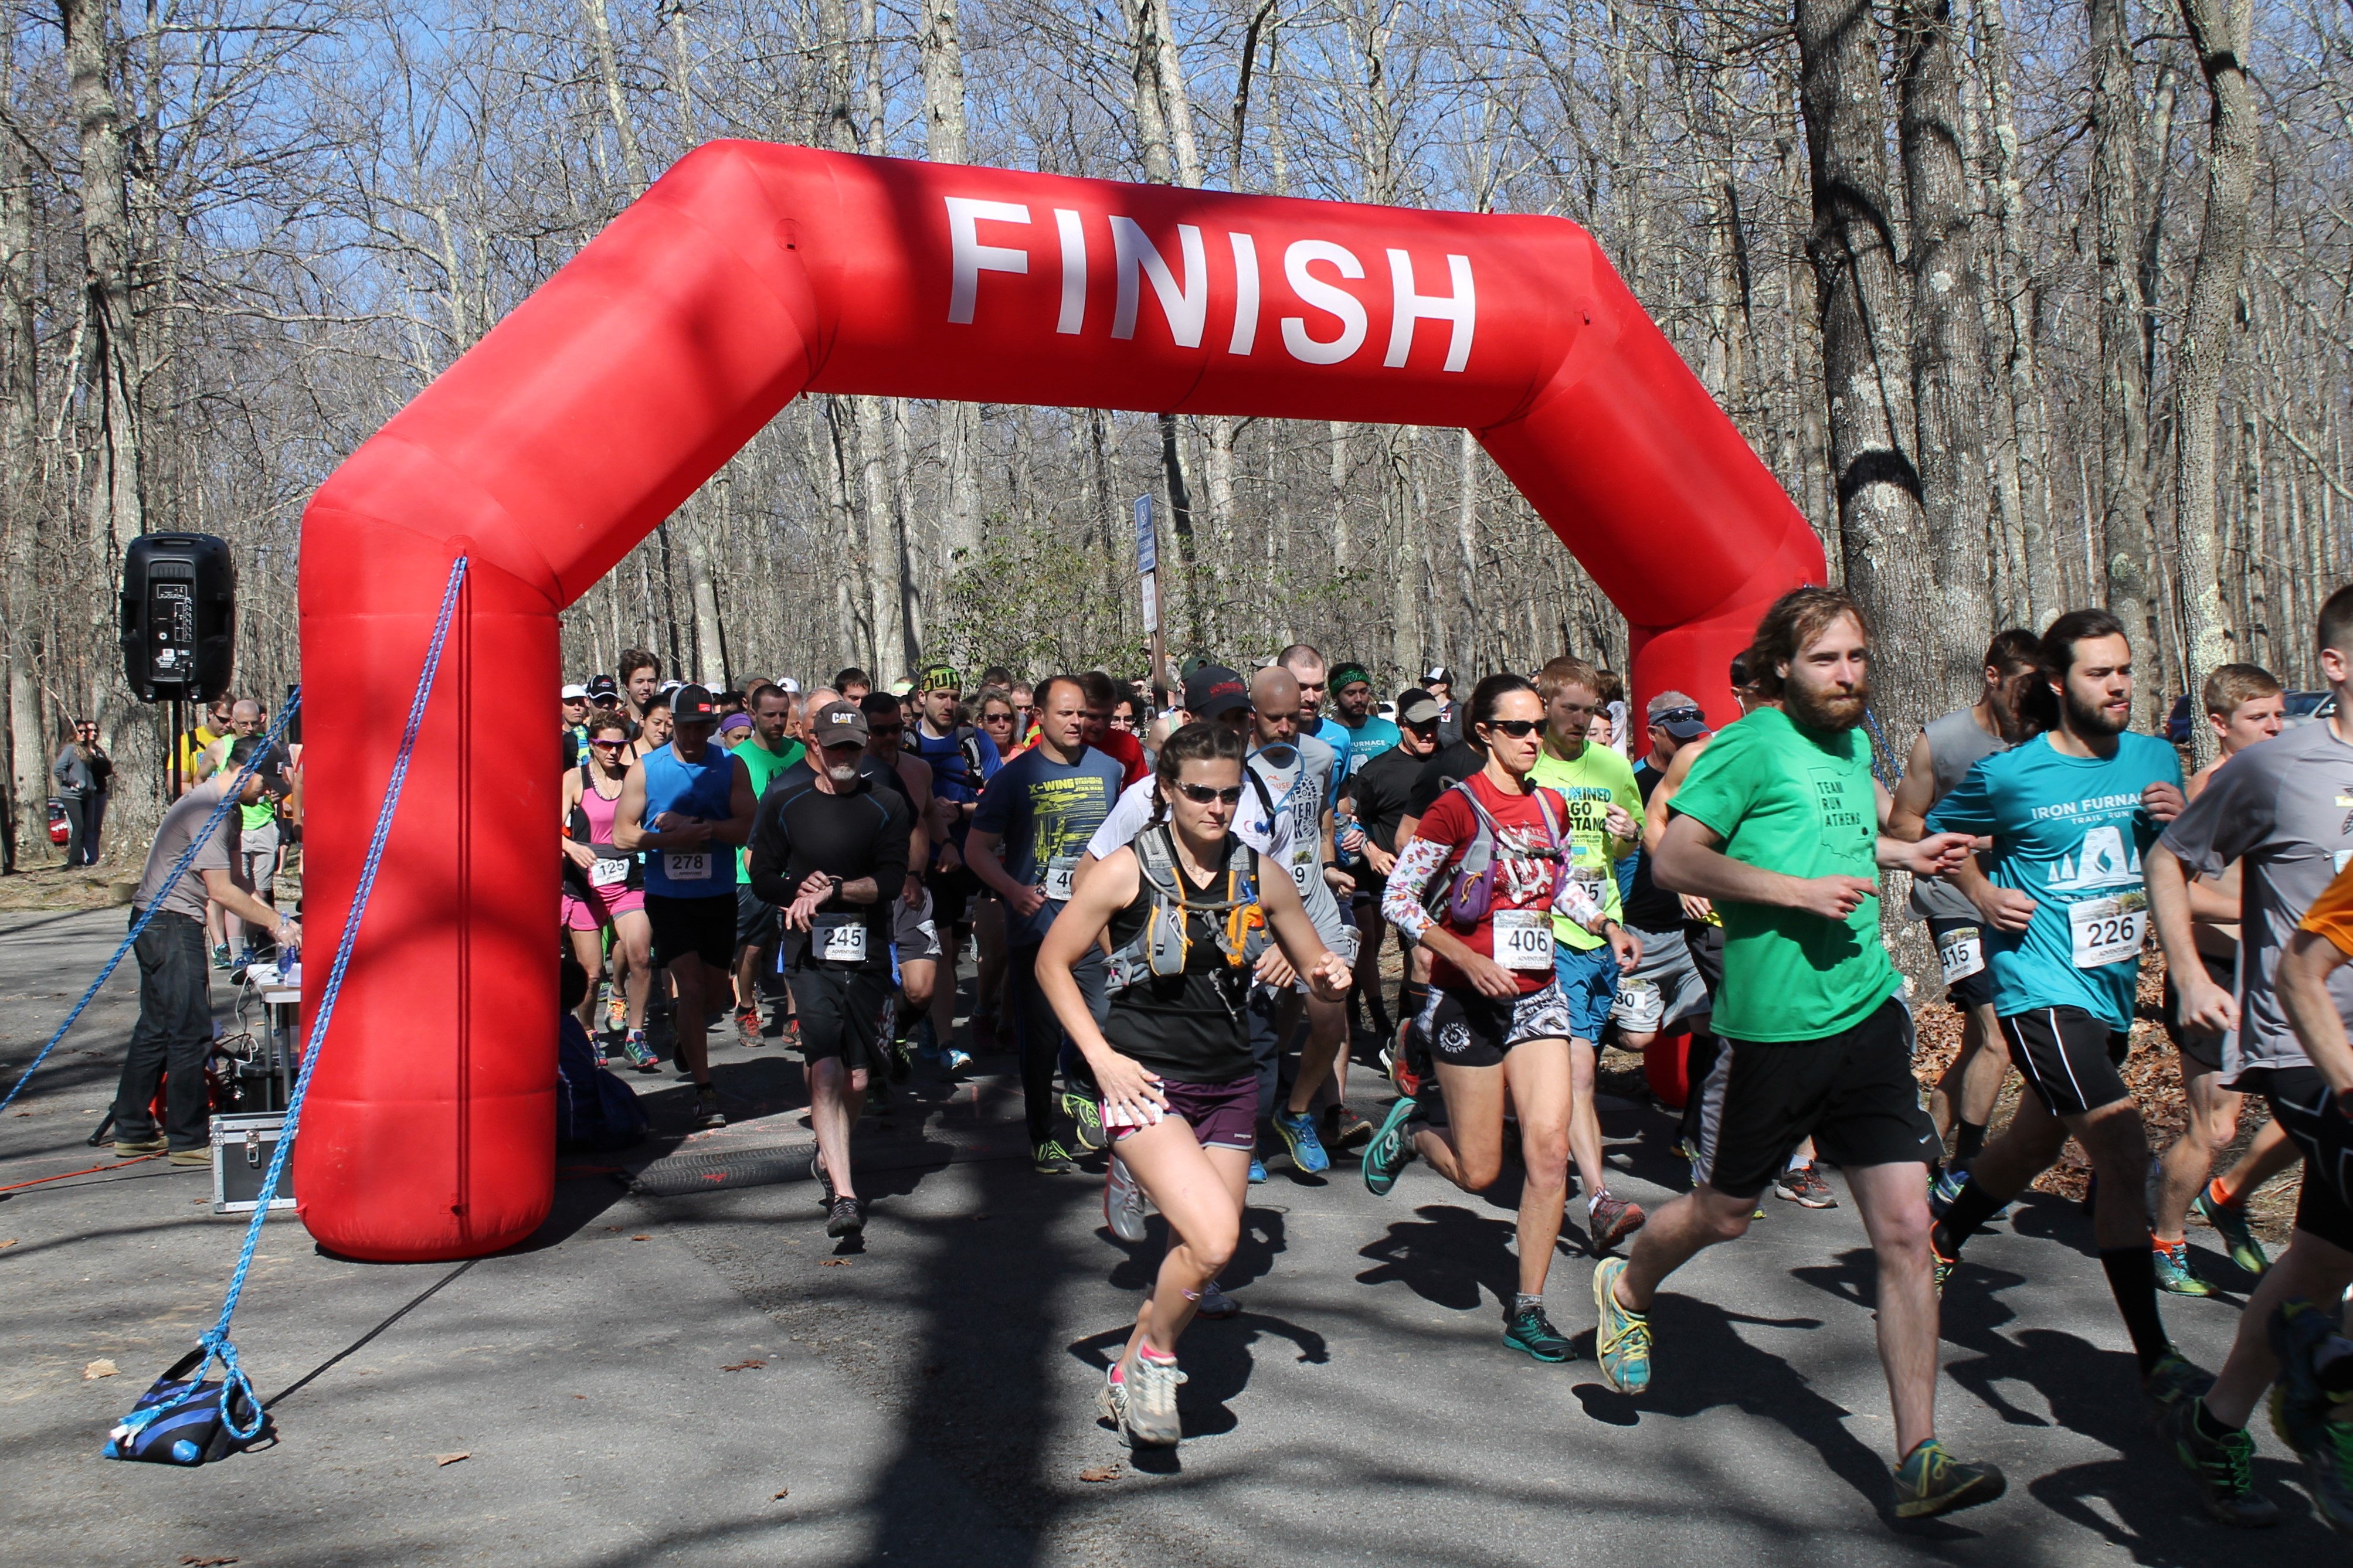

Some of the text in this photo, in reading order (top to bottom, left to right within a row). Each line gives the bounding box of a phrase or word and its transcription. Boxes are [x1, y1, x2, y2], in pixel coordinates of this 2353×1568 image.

[944, 196, 1476, 372] FINISH
[832, 712, 853, 724] CAT
[1028, 778, 1074, 794] X-WING
[1816, 781, 1844, 794] TEAM
[1553, 787, 1612, 802] RMINED
[1570, 802, 1591, 816] GO
[1821, 797, 1843, 810] RUN
[2031, 792, 2143, 819] IRON FURNA
[1570, 817, 1606, 832] STANC
[1825, 812, 1860, 827] ATHENS
[2071, 810, 2130, 825] TRAIL RUN
[1293, 819, 1303, 839] K
[599, 860, 624, 875] 125
[673, 855, 703, 869] 278
[1291, 867, 1305, 883] 9
[823, 928, 861, 947] 245
[2087, 917, 2134, 947] 226
[1509, 930, 1547, 951] 406
[1942, 943, 1969, 968] 415
